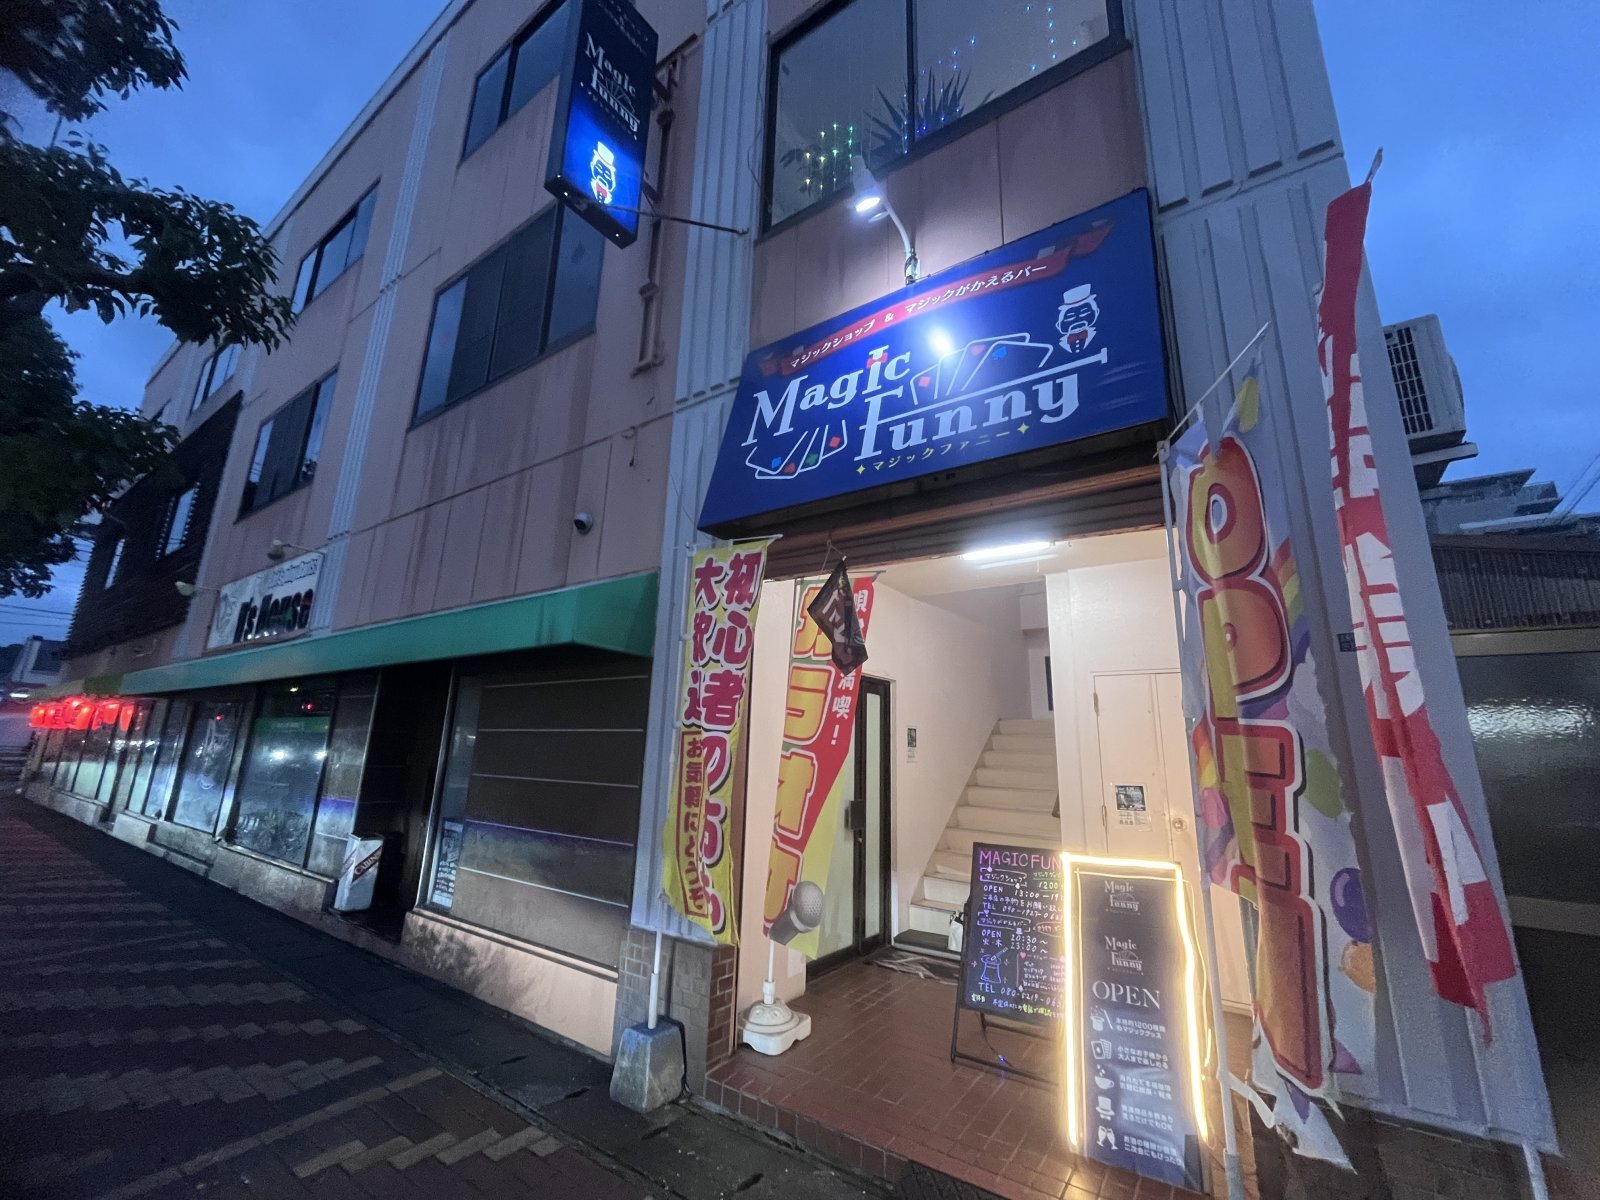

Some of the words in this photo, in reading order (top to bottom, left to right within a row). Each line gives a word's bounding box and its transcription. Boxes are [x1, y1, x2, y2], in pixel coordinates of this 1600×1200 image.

[585, 31, 637, 98] Magic
[590, 65, 641, 133] Funny
[789, 319, 876, 368] マジックショップ
[883, 311, 895, 323] &
[904, 264, 1048, 314] マジックがかえるバー
[741, 345, 912, 447] Magic
[853, 350, 1107, 462] Funny
[872, 430, 1012, 473] マジックファニー
[983, 885, 1003, 893] OPEN
[1104, 880, 1135, 893] Magic
[983, 902, 996, 910] TEL
[1109, 893, 1140, 912] Funny
[981, 929, 1002, 938] OPEN
[1104, 935, 1138, 951] Magic
[1111, 951, 1143, 971] Funny
[978, 982, 995, 994] TEL
[1092, 980, 1161, 1009] OPEN
